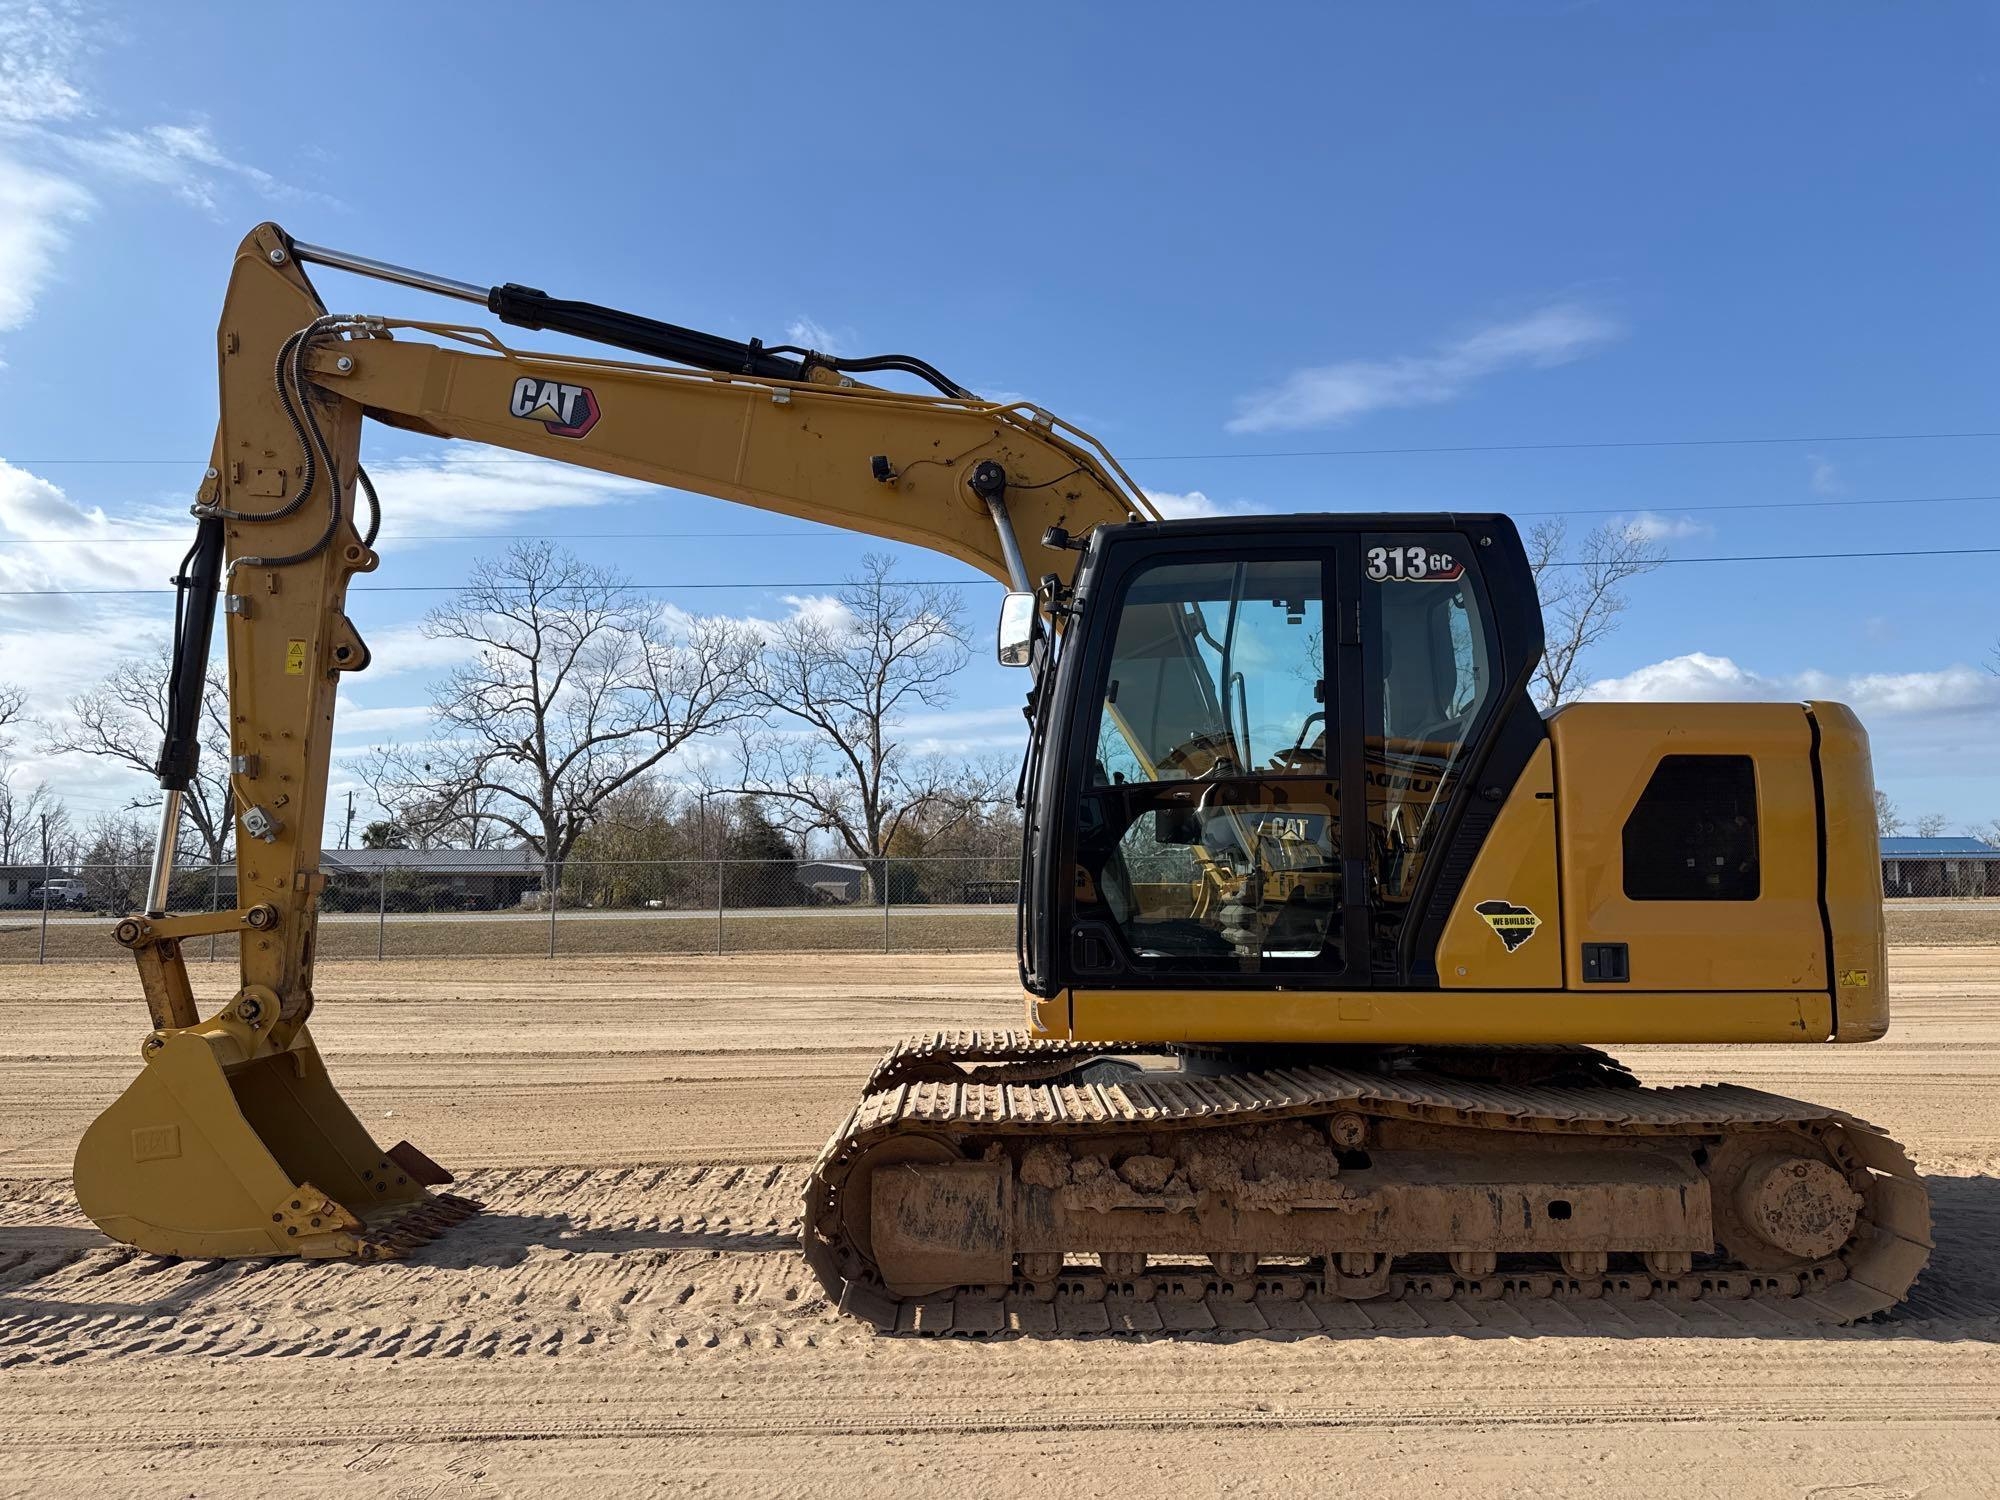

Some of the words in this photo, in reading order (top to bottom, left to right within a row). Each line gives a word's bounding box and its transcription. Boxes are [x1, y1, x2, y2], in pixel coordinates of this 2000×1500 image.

[511, 377, 583, 425] CAT
[1367, 546, 1427, 579] 313
[1429, 553, 1453, 571] GC
[1271, 817, 1309, 841] CAT
[1492, 917, 1504, 926] WE
[1504, 917, 1525, 926] BUILD
[1526, 917, 1536, 926] SC
